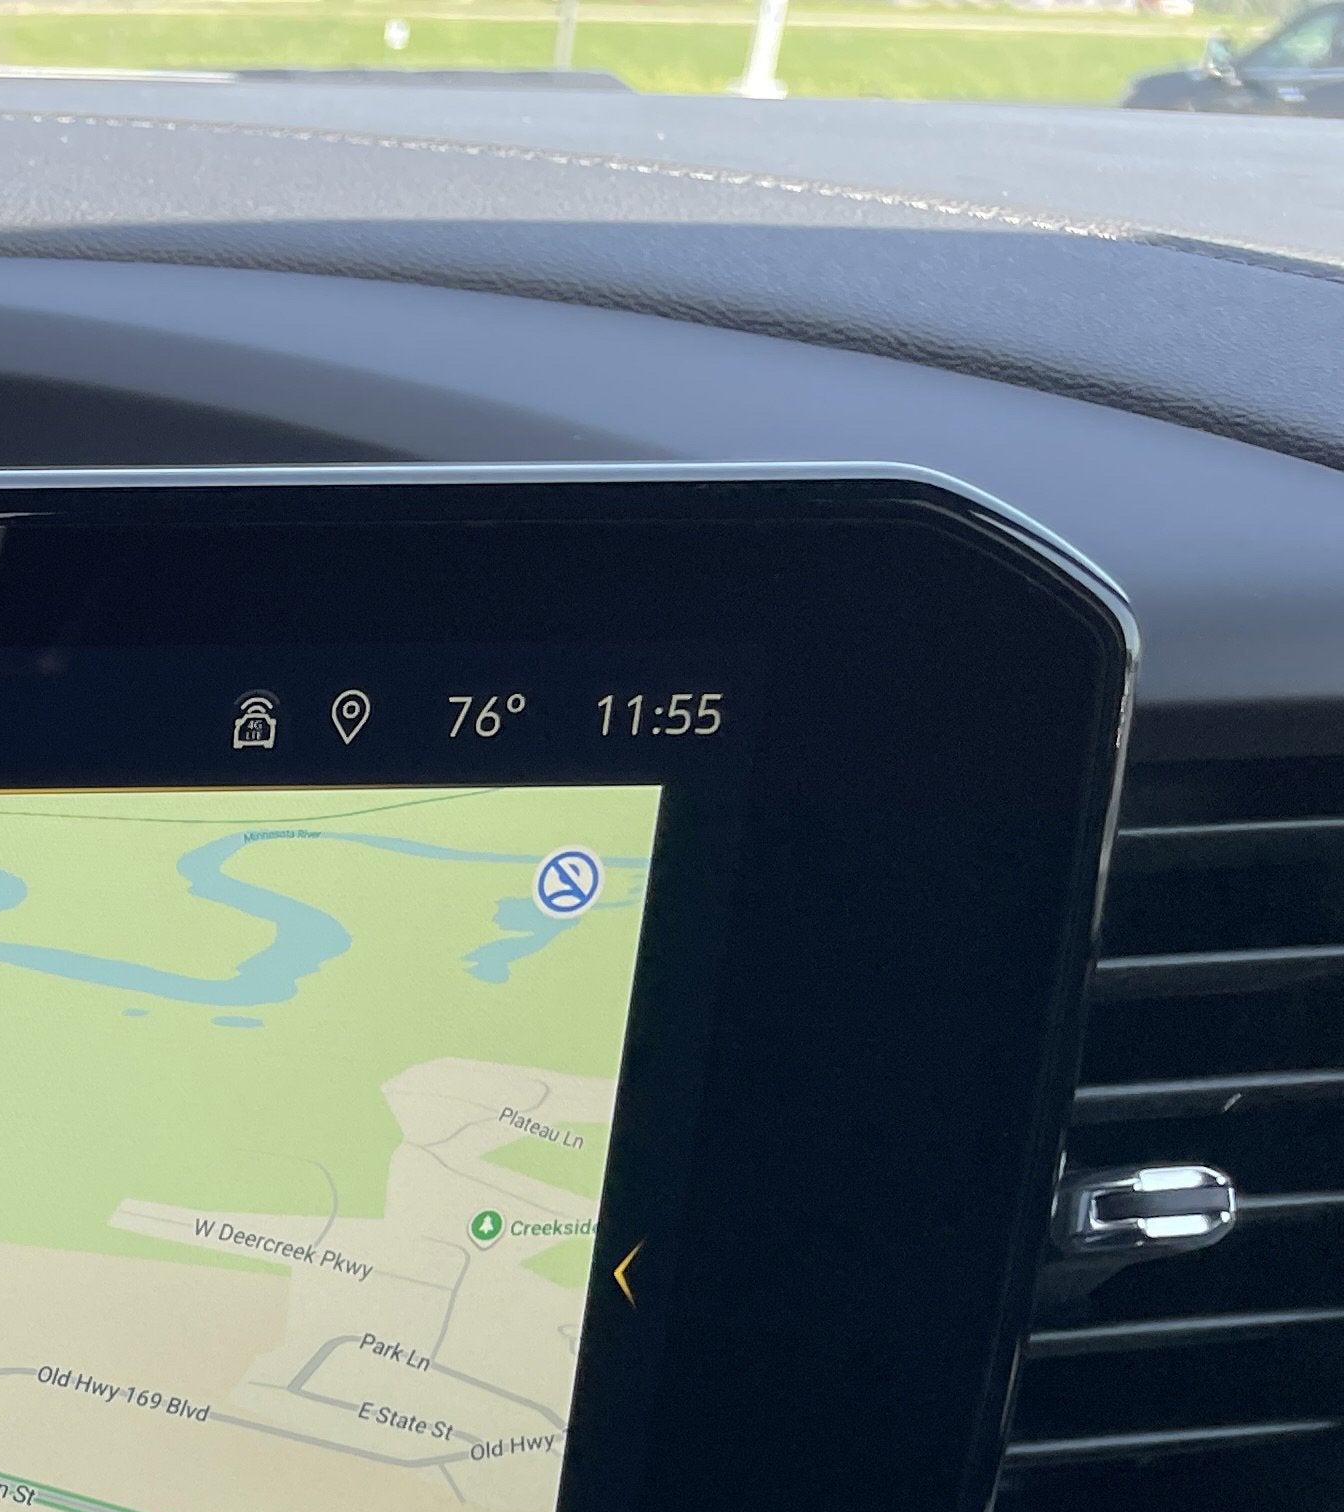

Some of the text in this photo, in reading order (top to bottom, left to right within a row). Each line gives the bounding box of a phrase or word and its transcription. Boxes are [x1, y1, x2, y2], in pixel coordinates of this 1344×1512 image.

[448, 694, 526, 738] 76°
[596, 694, 723, 735] 11:55
[499, 1108, 584, 1149] Plateau Ln
[194, 1219, 374, 1282] W Deercreek Pkwy
[359, 1334, 431, 1371] Park Ln
[37, 1367, 210, 1421] Old Hwy 169 Blvd
[358, 1403, 454, 1441] E State St
[470, 1434, 555, 1461] Old Hwy
[12, 1485, 36, 1506] St
